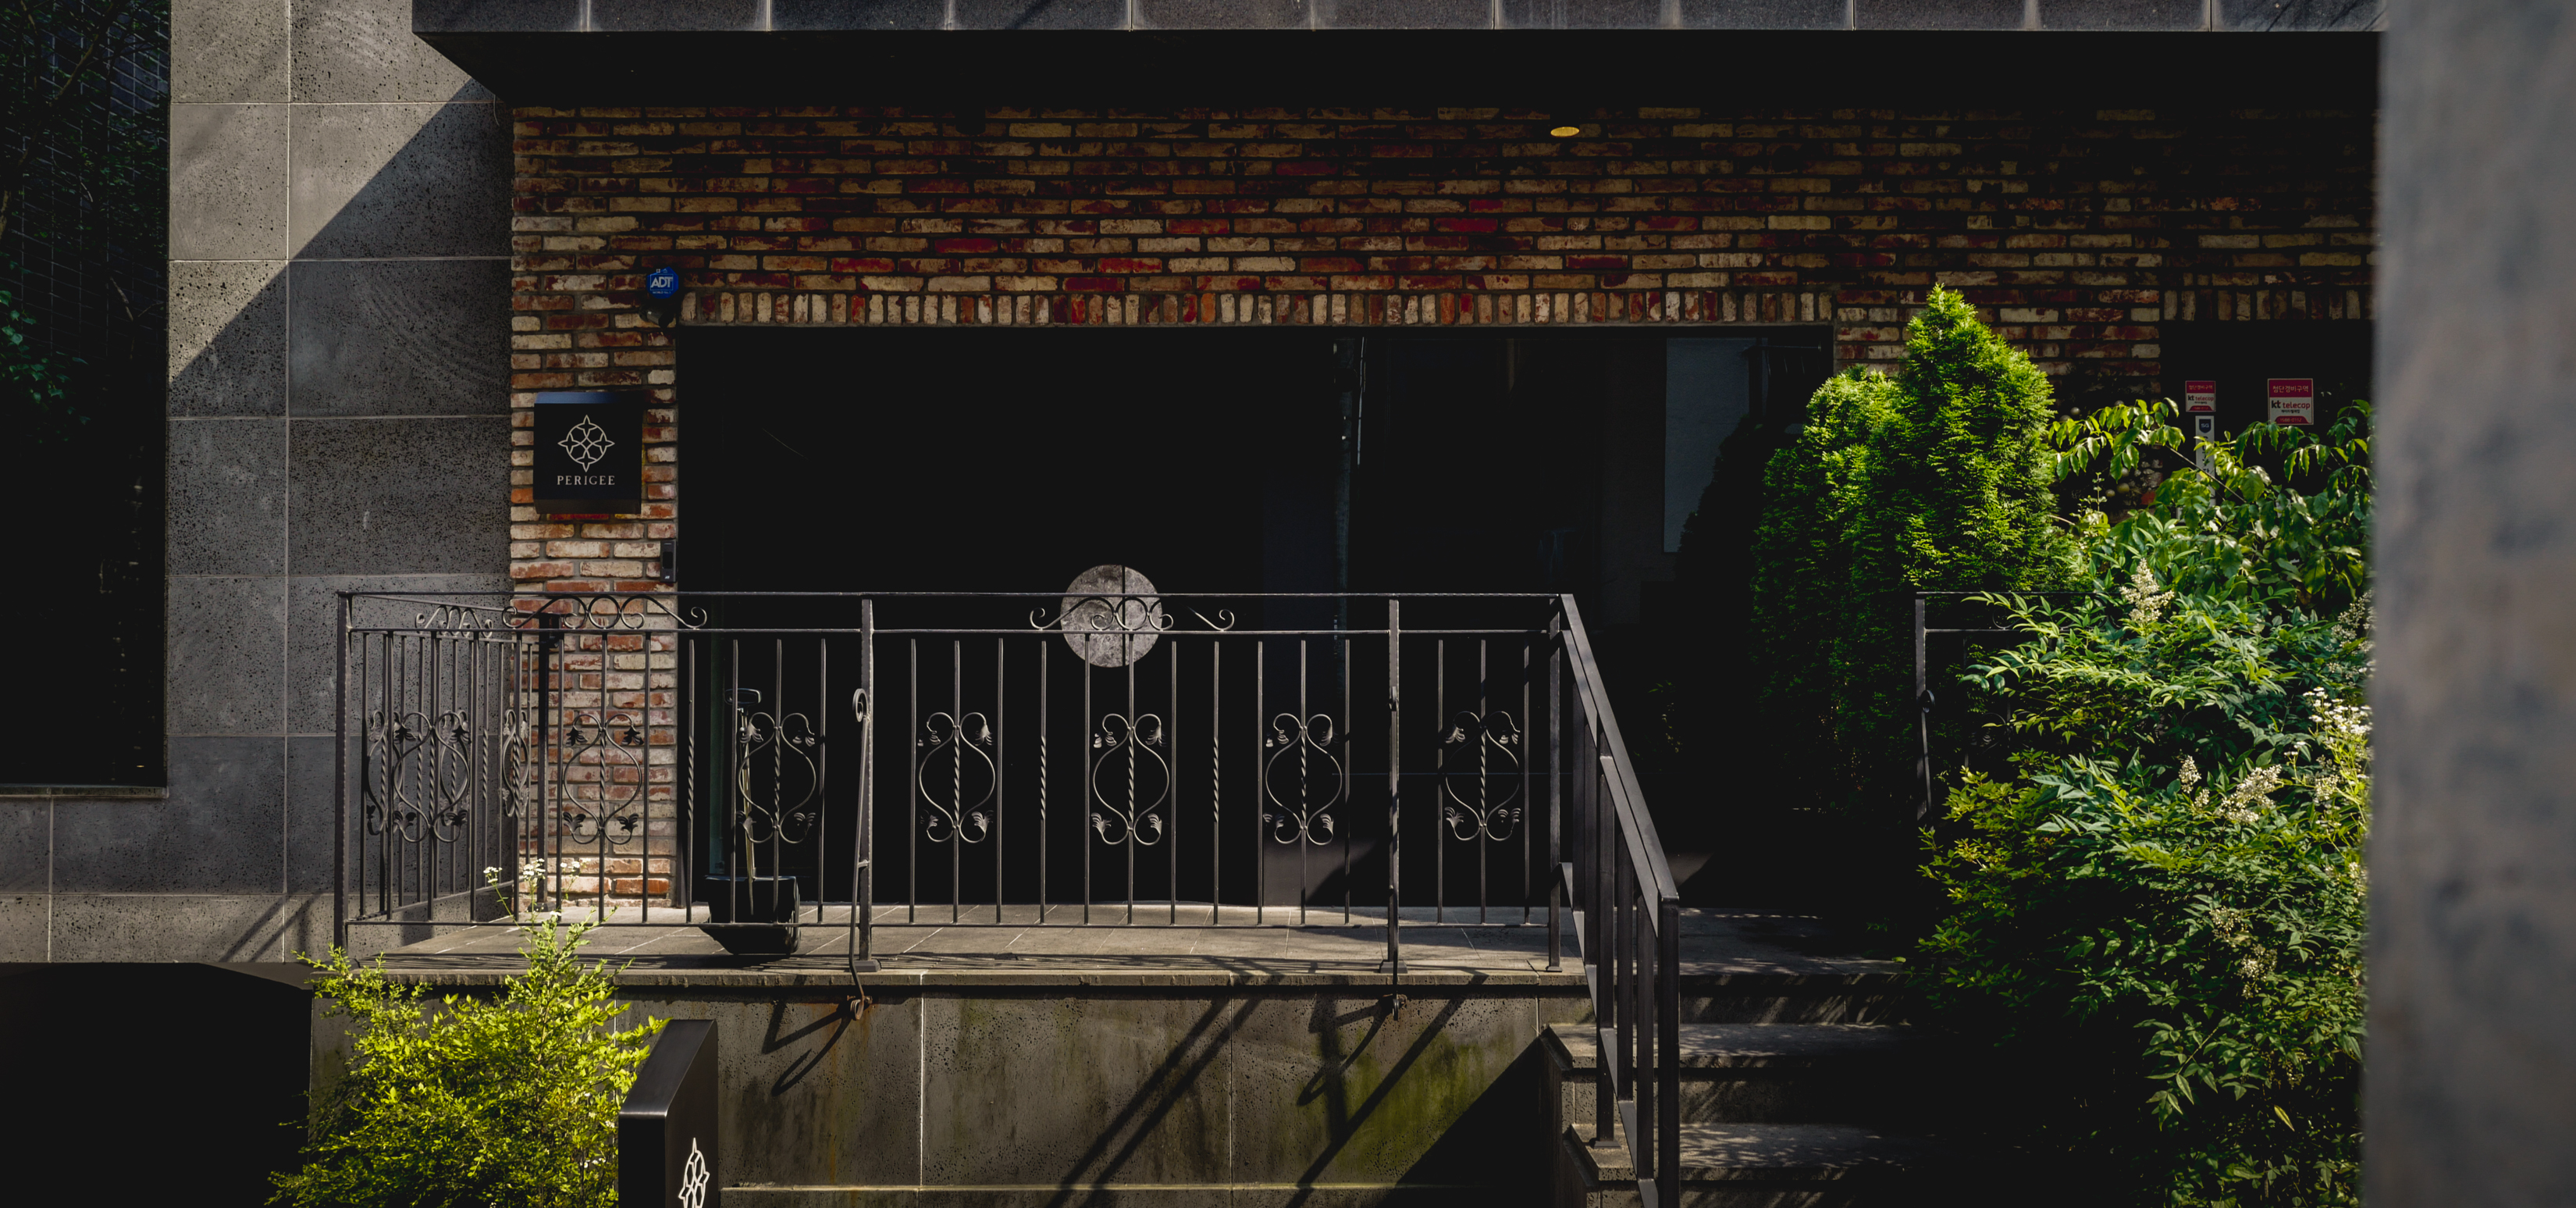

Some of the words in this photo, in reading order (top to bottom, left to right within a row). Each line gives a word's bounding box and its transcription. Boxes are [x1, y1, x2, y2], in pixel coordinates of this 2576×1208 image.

[650, 276, 673, 287] ADT
[2272, 400, 2281, 408] kt
[2282, 401, 2311, 410] telecop
[557, 475, 615, 486] PERIGEE
